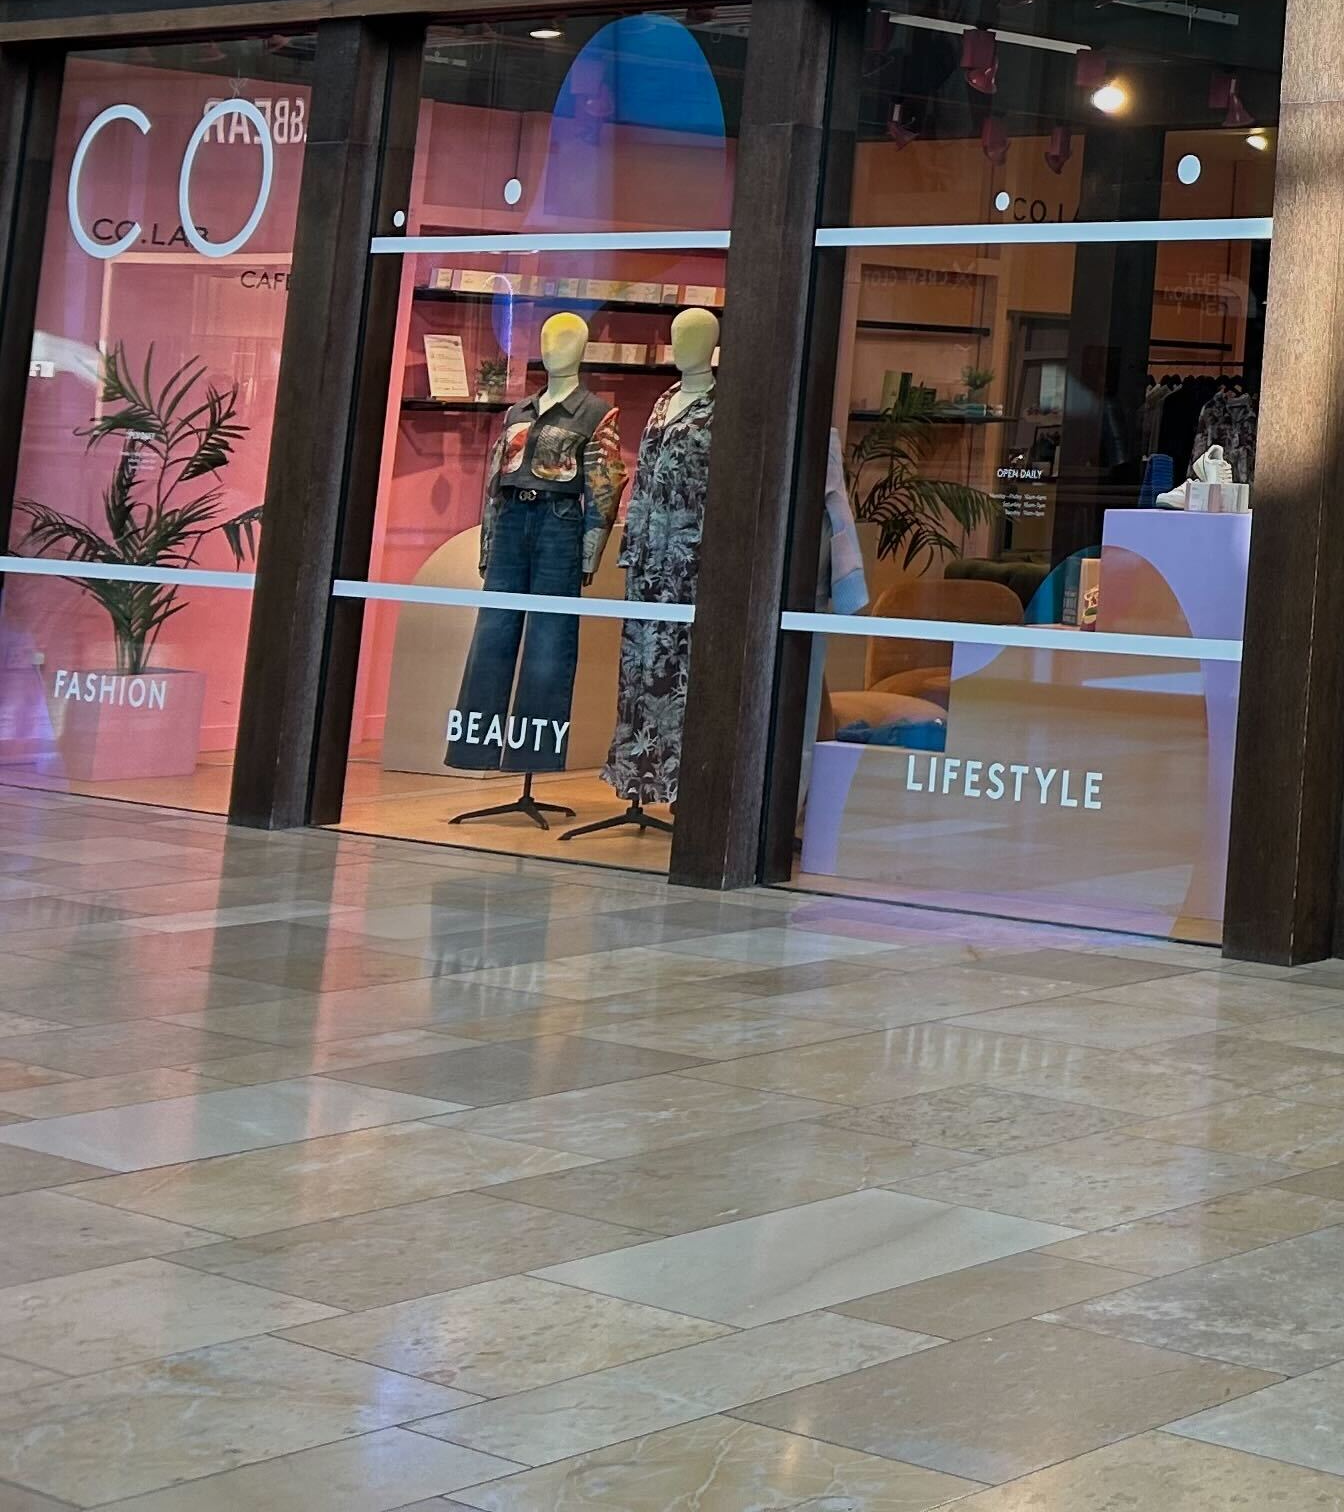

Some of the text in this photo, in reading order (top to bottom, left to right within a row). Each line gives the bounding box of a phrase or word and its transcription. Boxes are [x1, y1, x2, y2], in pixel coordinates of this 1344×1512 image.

[68, 98, 273, 259] CO
[997, 469, 1018, 479] OPEN
[55, 670, 167, 711] FASHION
[447, 710, 570, 754] BEAUTY
[906, 755, 1103, 810] LIFESTYLE
